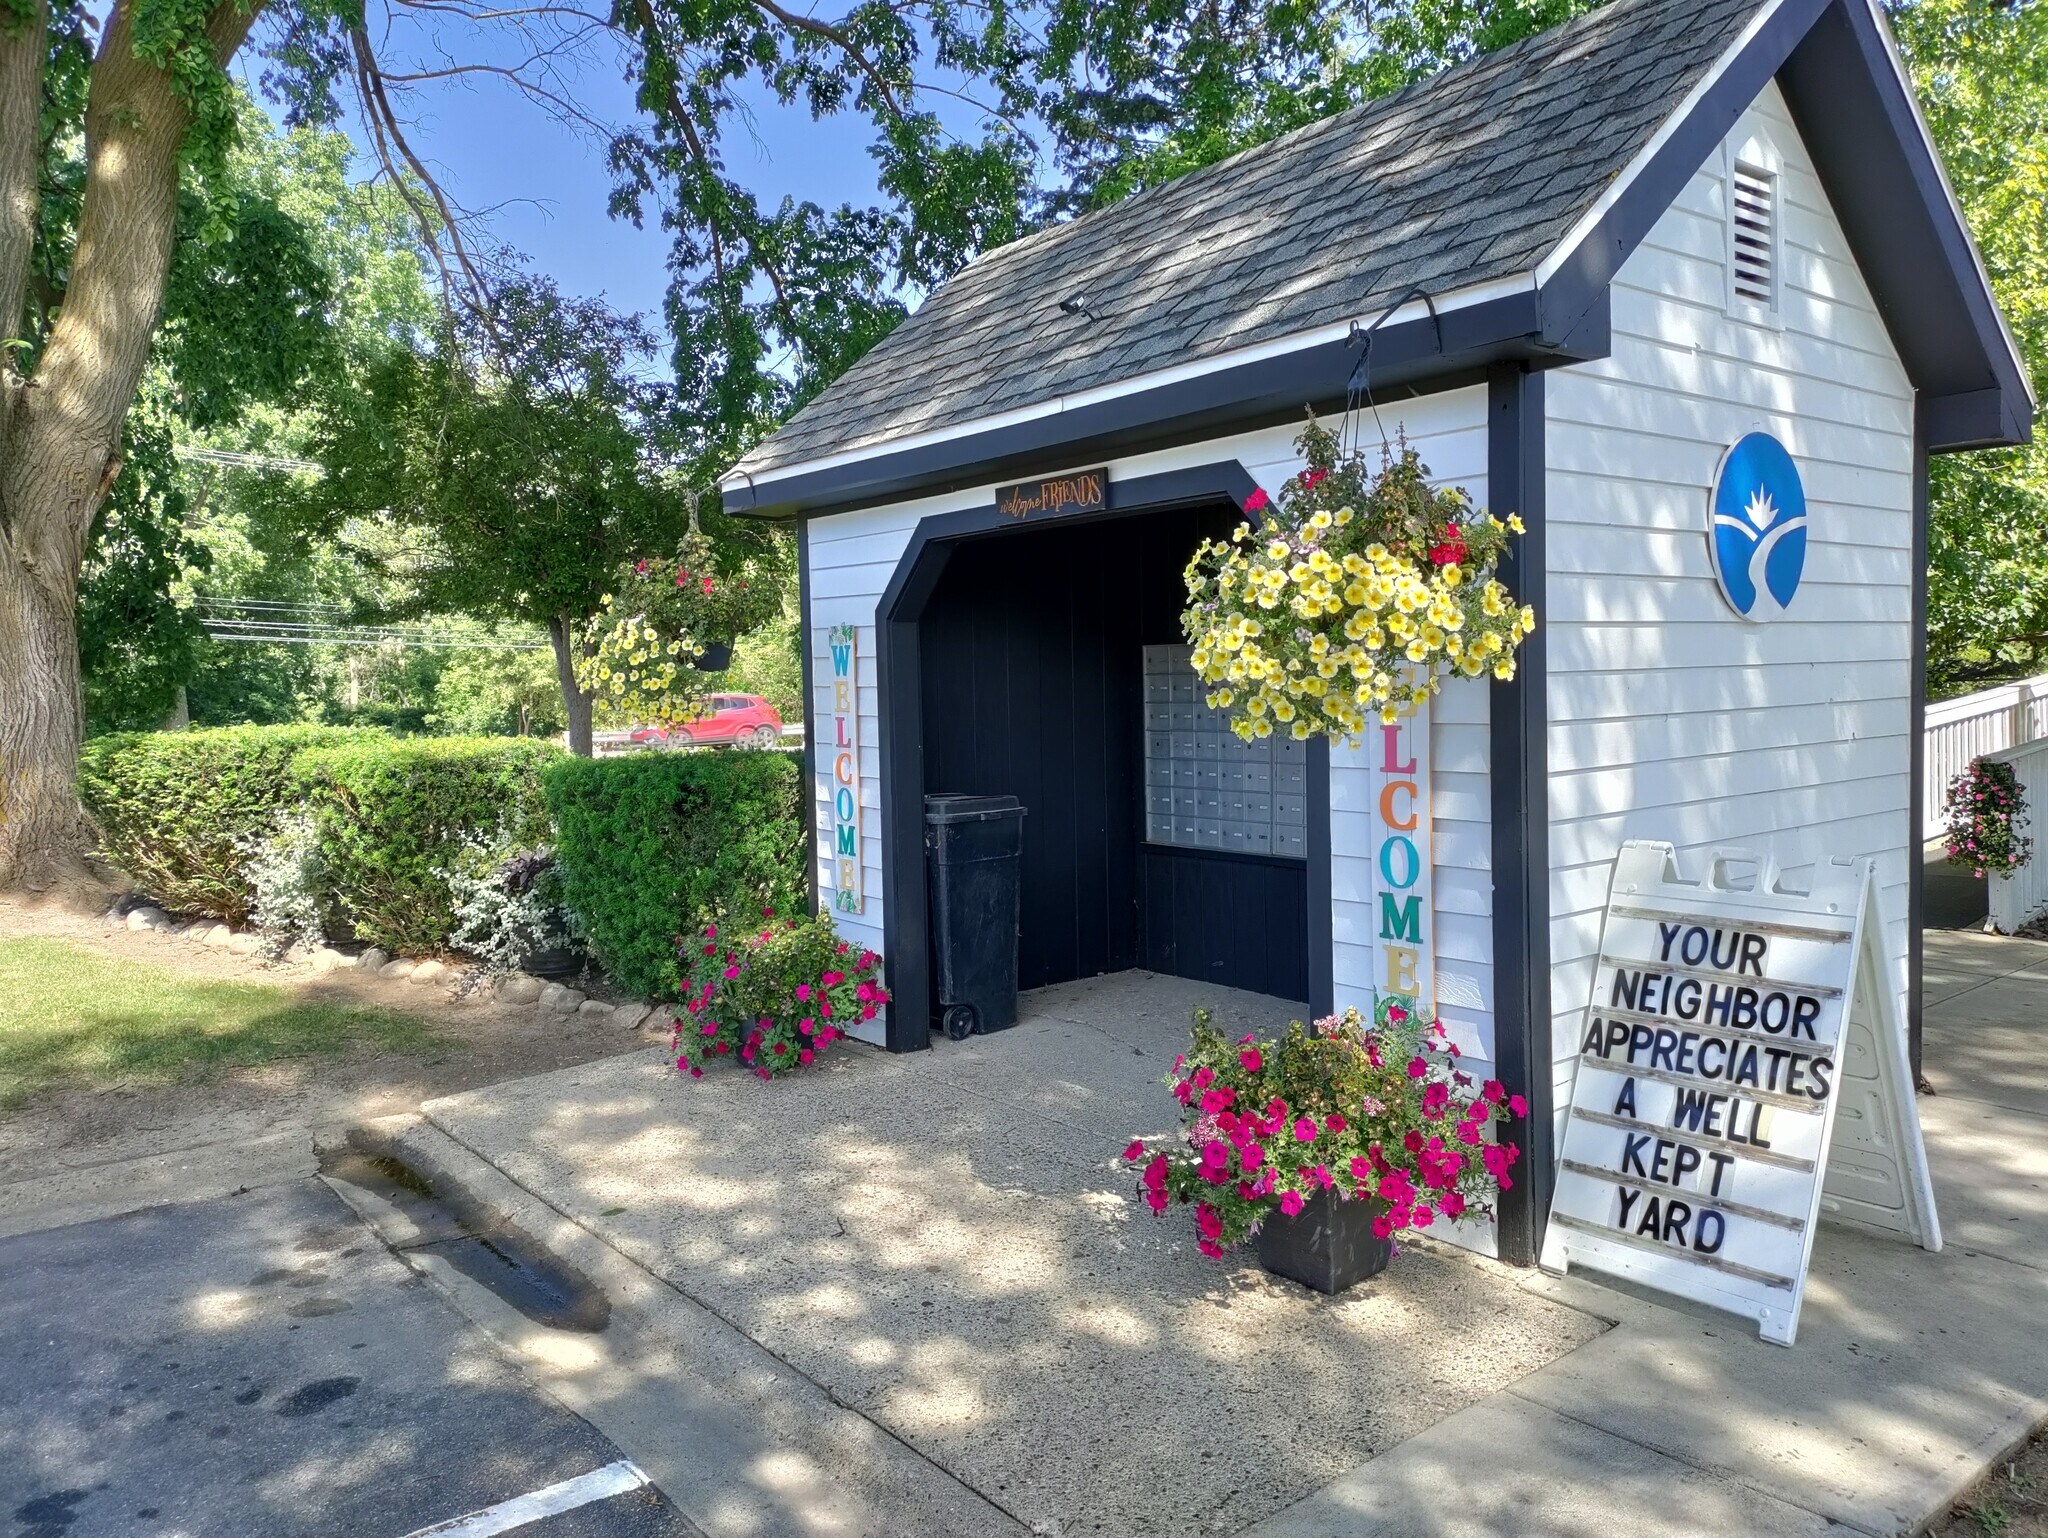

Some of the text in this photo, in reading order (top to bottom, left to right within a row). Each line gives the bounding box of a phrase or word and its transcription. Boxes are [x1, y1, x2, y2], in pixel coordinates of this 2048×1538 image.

[830, 645, 857, 890] WELCOME
[1658, 922, 1768, 977] YOUR
[1610, 968, 1821, 1041] NEIGHBOR
[1581, 1017, 1834, 1101] APPRECIATES
[1614, 1077, 1771, 1149] A WELL
[1621, 1132, 1735, 1197] KEPT
[1617, 1186, 1726, 1254] YARD
